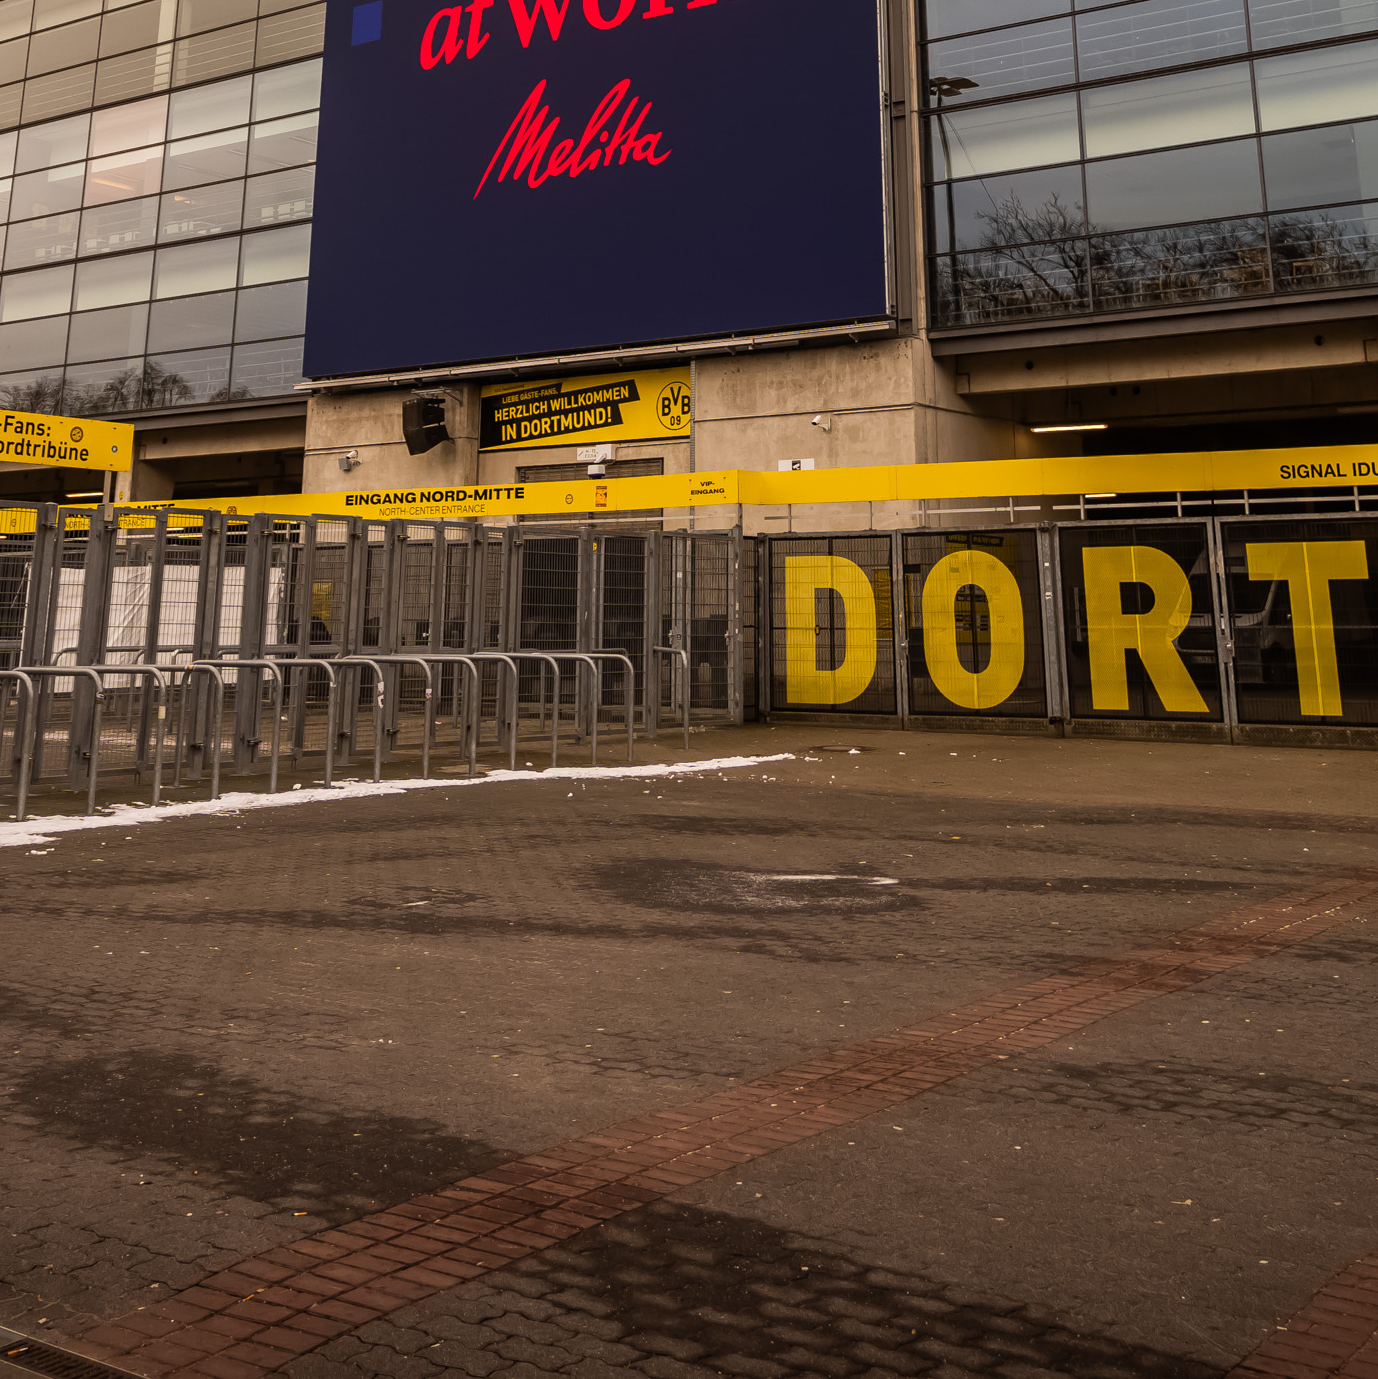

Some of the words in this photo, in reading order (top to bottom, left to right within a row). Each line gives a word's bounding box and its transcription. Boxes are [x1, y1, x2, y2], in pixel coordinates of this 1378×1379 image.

[472, 78, 673, 200] Melitta
[494, 400, 548, 422] HERZLICH
[550, 385, 629, 412] WILLKOMMEN
[502, 394, 519, 404] LIEBE
[661, 385, 691, 417] BVB
[502, 423, 517, 442] IN
[521, 405, 613, 438] DORTMUND!
[670, 415, 681, 426] 09
[1279, 463, 1348, 480] SIGNAL
[345, 490, 417, 506] EINGANG
[419, 487, 525, 503] NORD-MITTE
[690, 487, 725, 495] EINGANG
[379, 505, 440, 517] NORTH-CENTER
[441, 503, 485, 515] ENTRANCE
